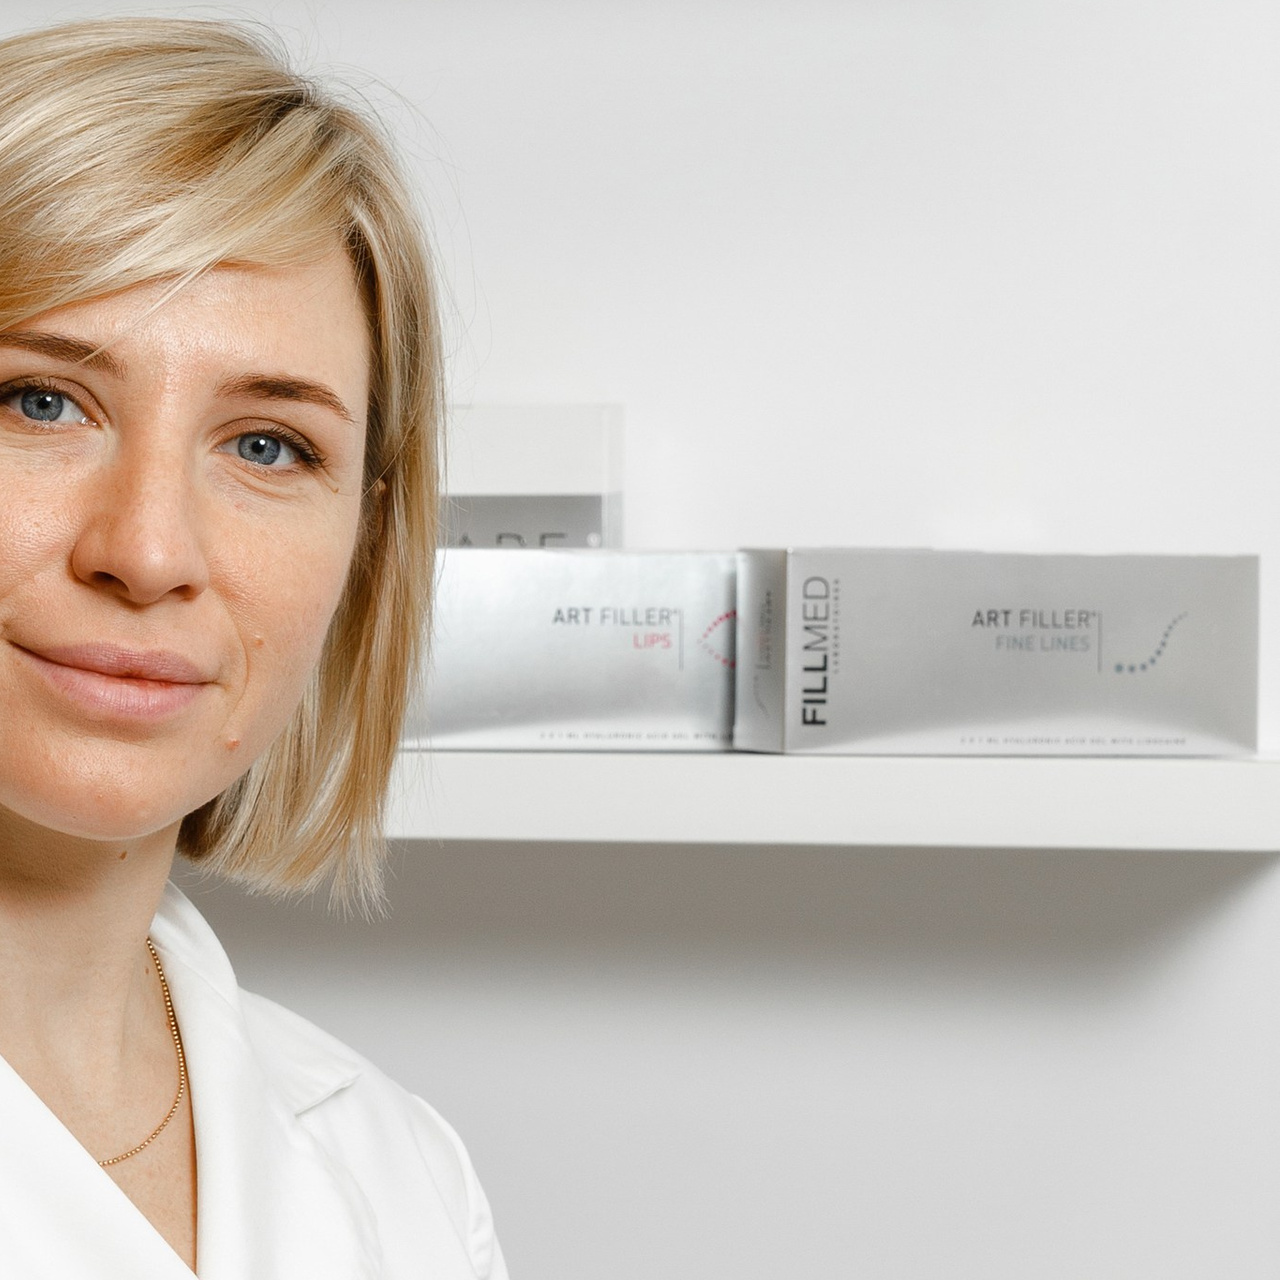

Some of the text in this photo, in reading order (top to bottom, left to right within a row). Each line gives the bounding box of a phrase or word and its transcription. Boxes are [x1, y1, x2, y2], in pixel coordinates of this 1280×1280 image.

[552, 607, 594, 626] ART
[971, 609, 1012, 629] ART
[633, 633, 673, 650] LIPS
[802, 576, 830, 726] FILLMED
[995, 635, 1091, 653] FINE LINES
